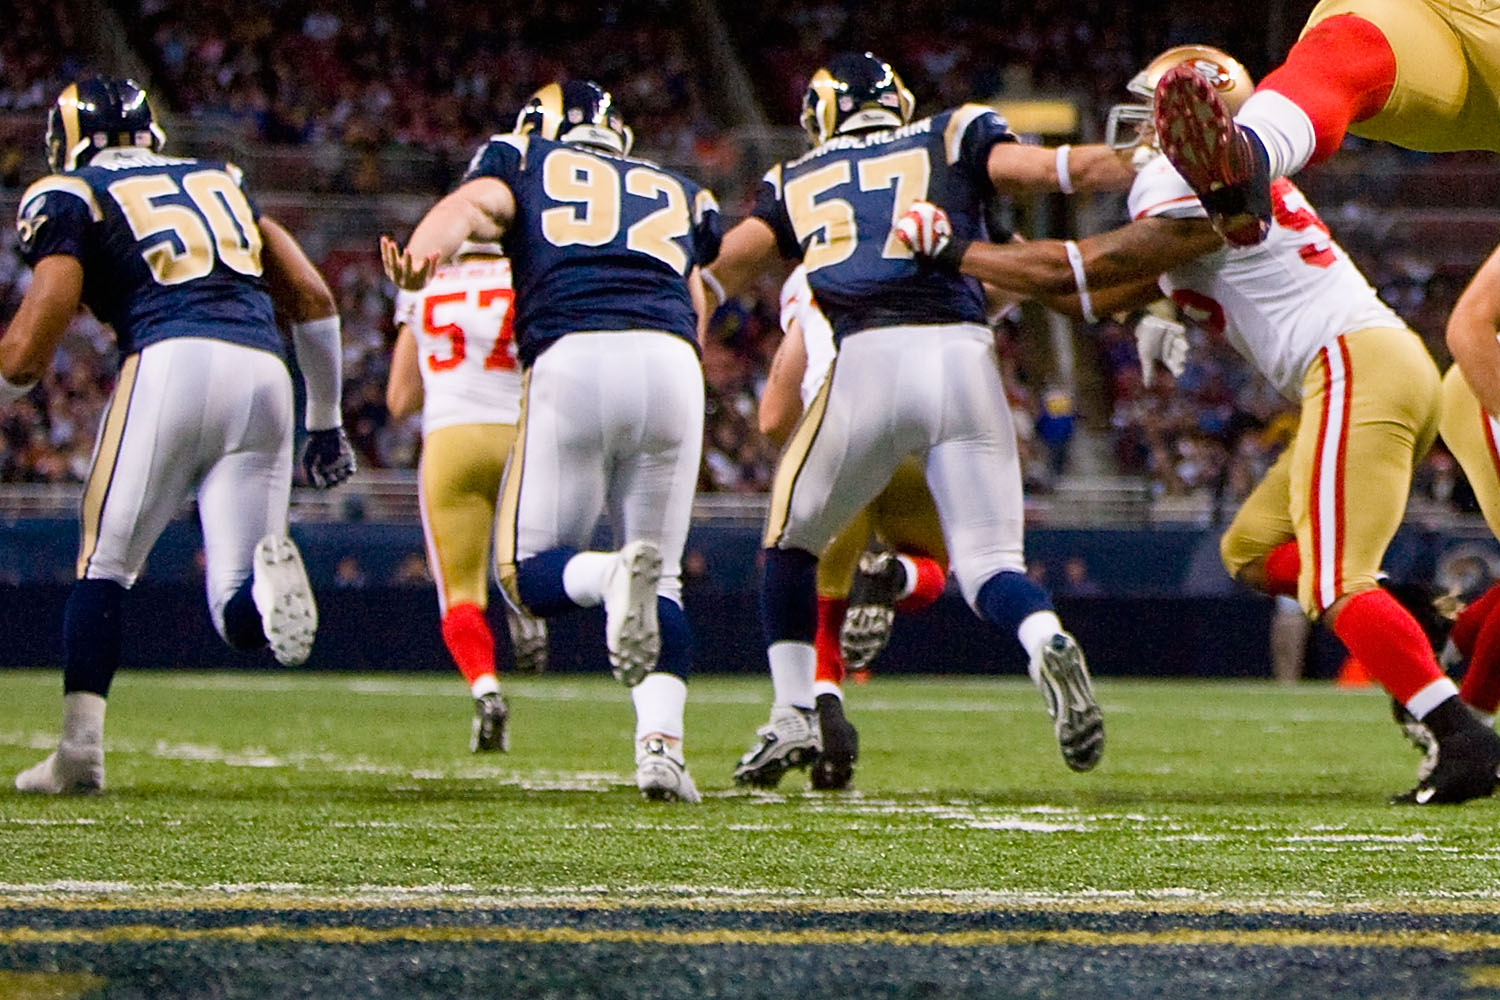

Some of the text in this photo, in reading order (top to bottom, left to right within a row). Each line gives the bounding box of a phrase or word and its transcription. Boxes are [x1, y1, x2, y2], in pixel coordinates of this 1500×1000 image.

[107, 169, 263, 286] 50
[541, 148, 690, 276] 92
[784, 147, 931, 274] 57
[423, 288, 516, 373] 57
